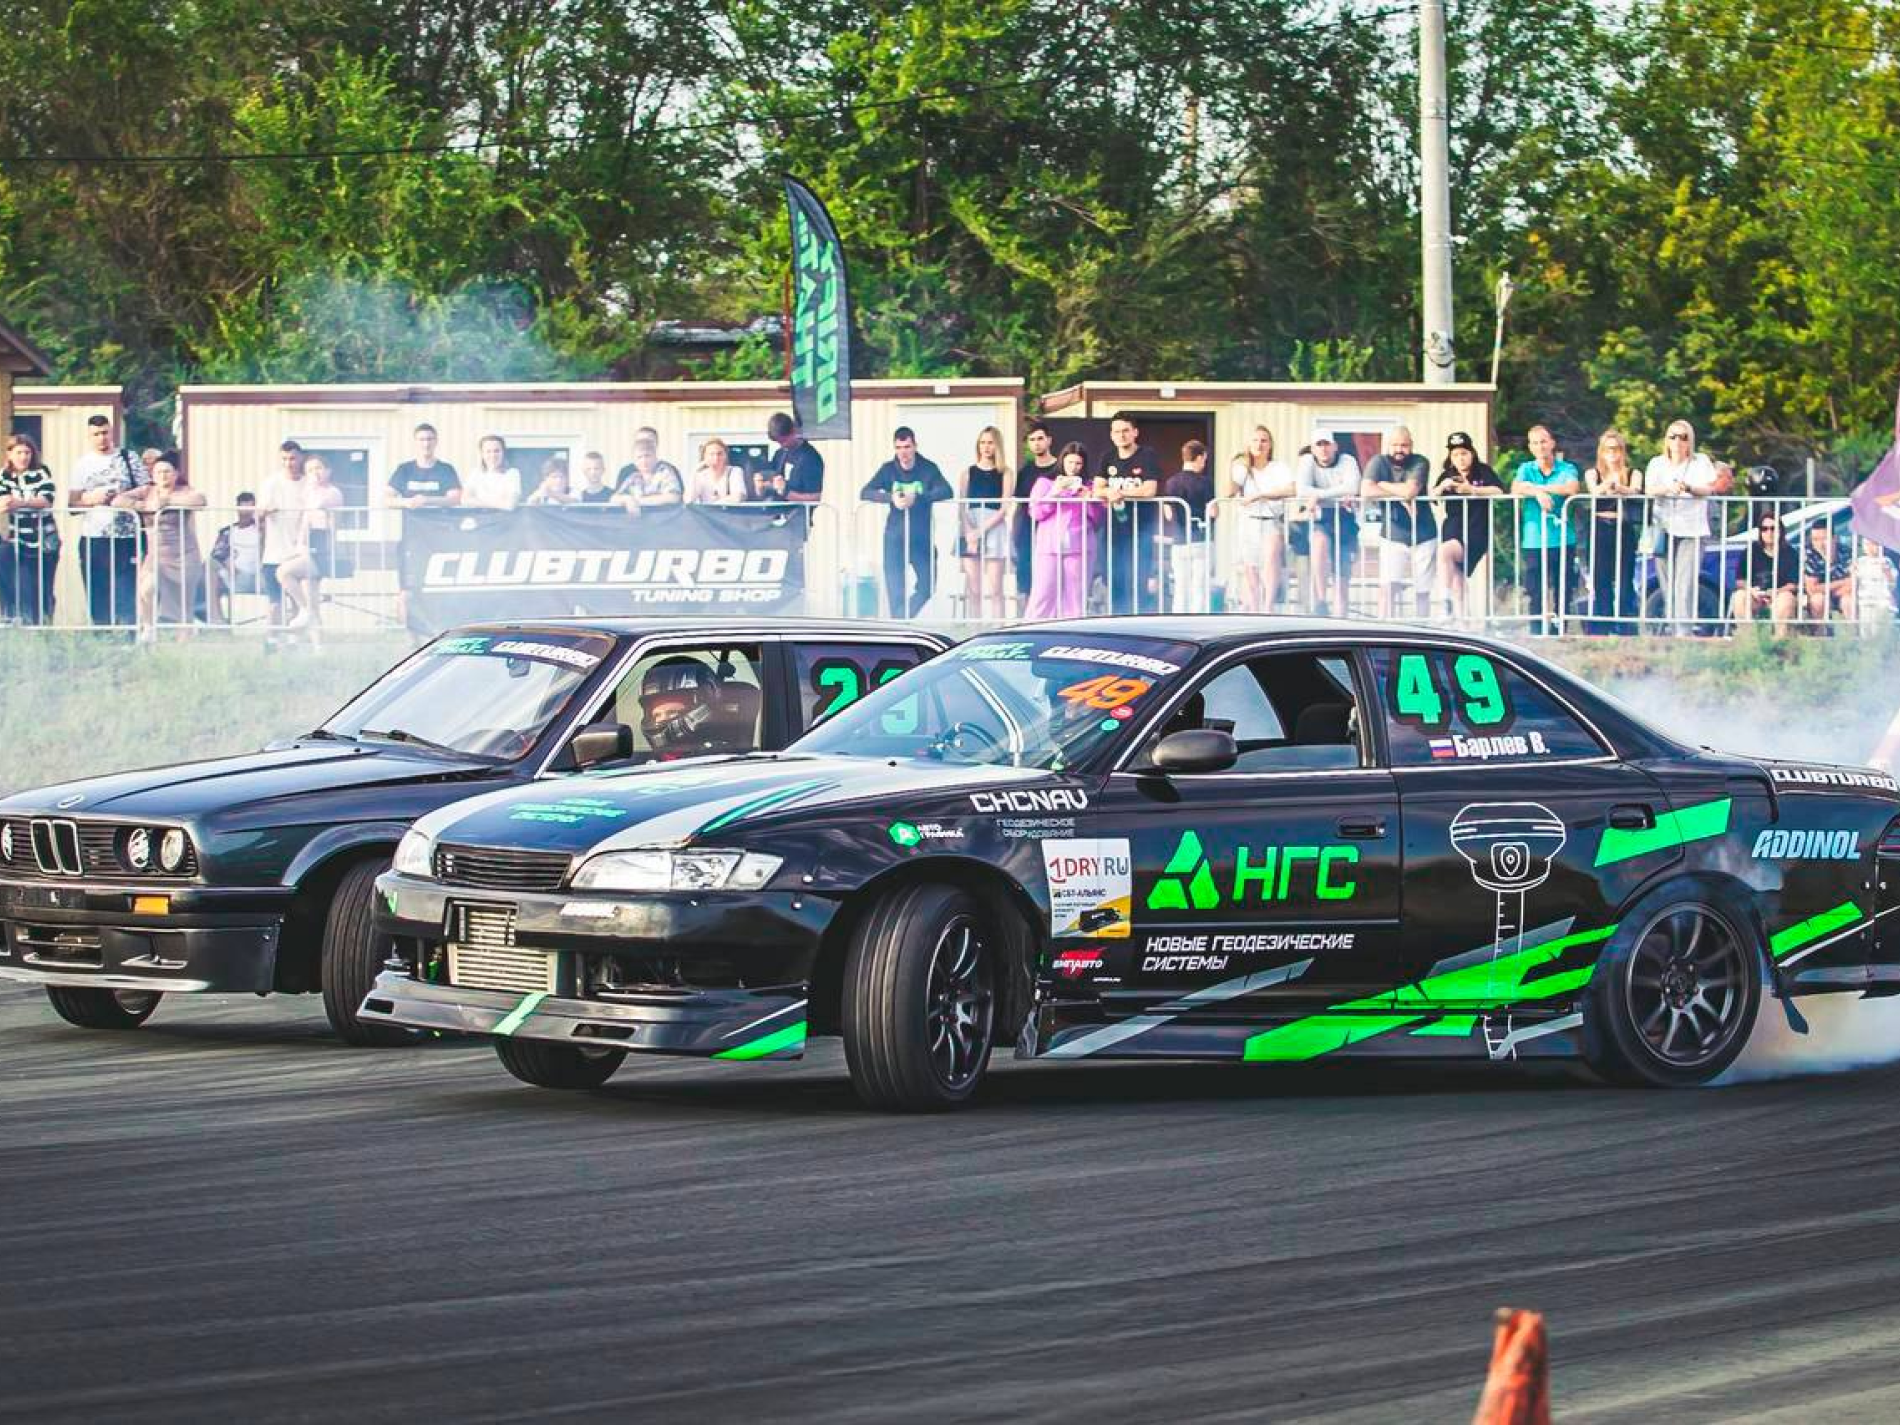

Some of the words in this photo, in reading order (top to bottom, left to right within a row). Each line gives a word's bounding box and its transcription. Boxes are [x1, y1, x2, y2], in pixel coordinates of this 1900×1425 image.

[423, 548, 789, 588] CLUBTURBO
[631, 588, 712, 603] TUNING
[718, 588, 781, 603] SHOP
[1038, 646, 1182, 676] CLUBTURBO
[1057, 674, 1152, 710] 49
[1397, 654, 1506, 724] 49
[1453, 734, 1528, 760] Барлев
[1770, 769, 1898, 792] CLUBTURBO
[969, 788, 1089, 813] CHCNAV
[1751, 829, 1861, 860] ADDINOL
[1232, 845, 1360, 902] НГС
[1145, 935, 1209, 953] НОВЫЕ
[1211, 933, 1356, 953] ГЕОДЕЗИЧЕСКИЕ
[1142, 955, 1230, 972] СИСТЕМЫ
